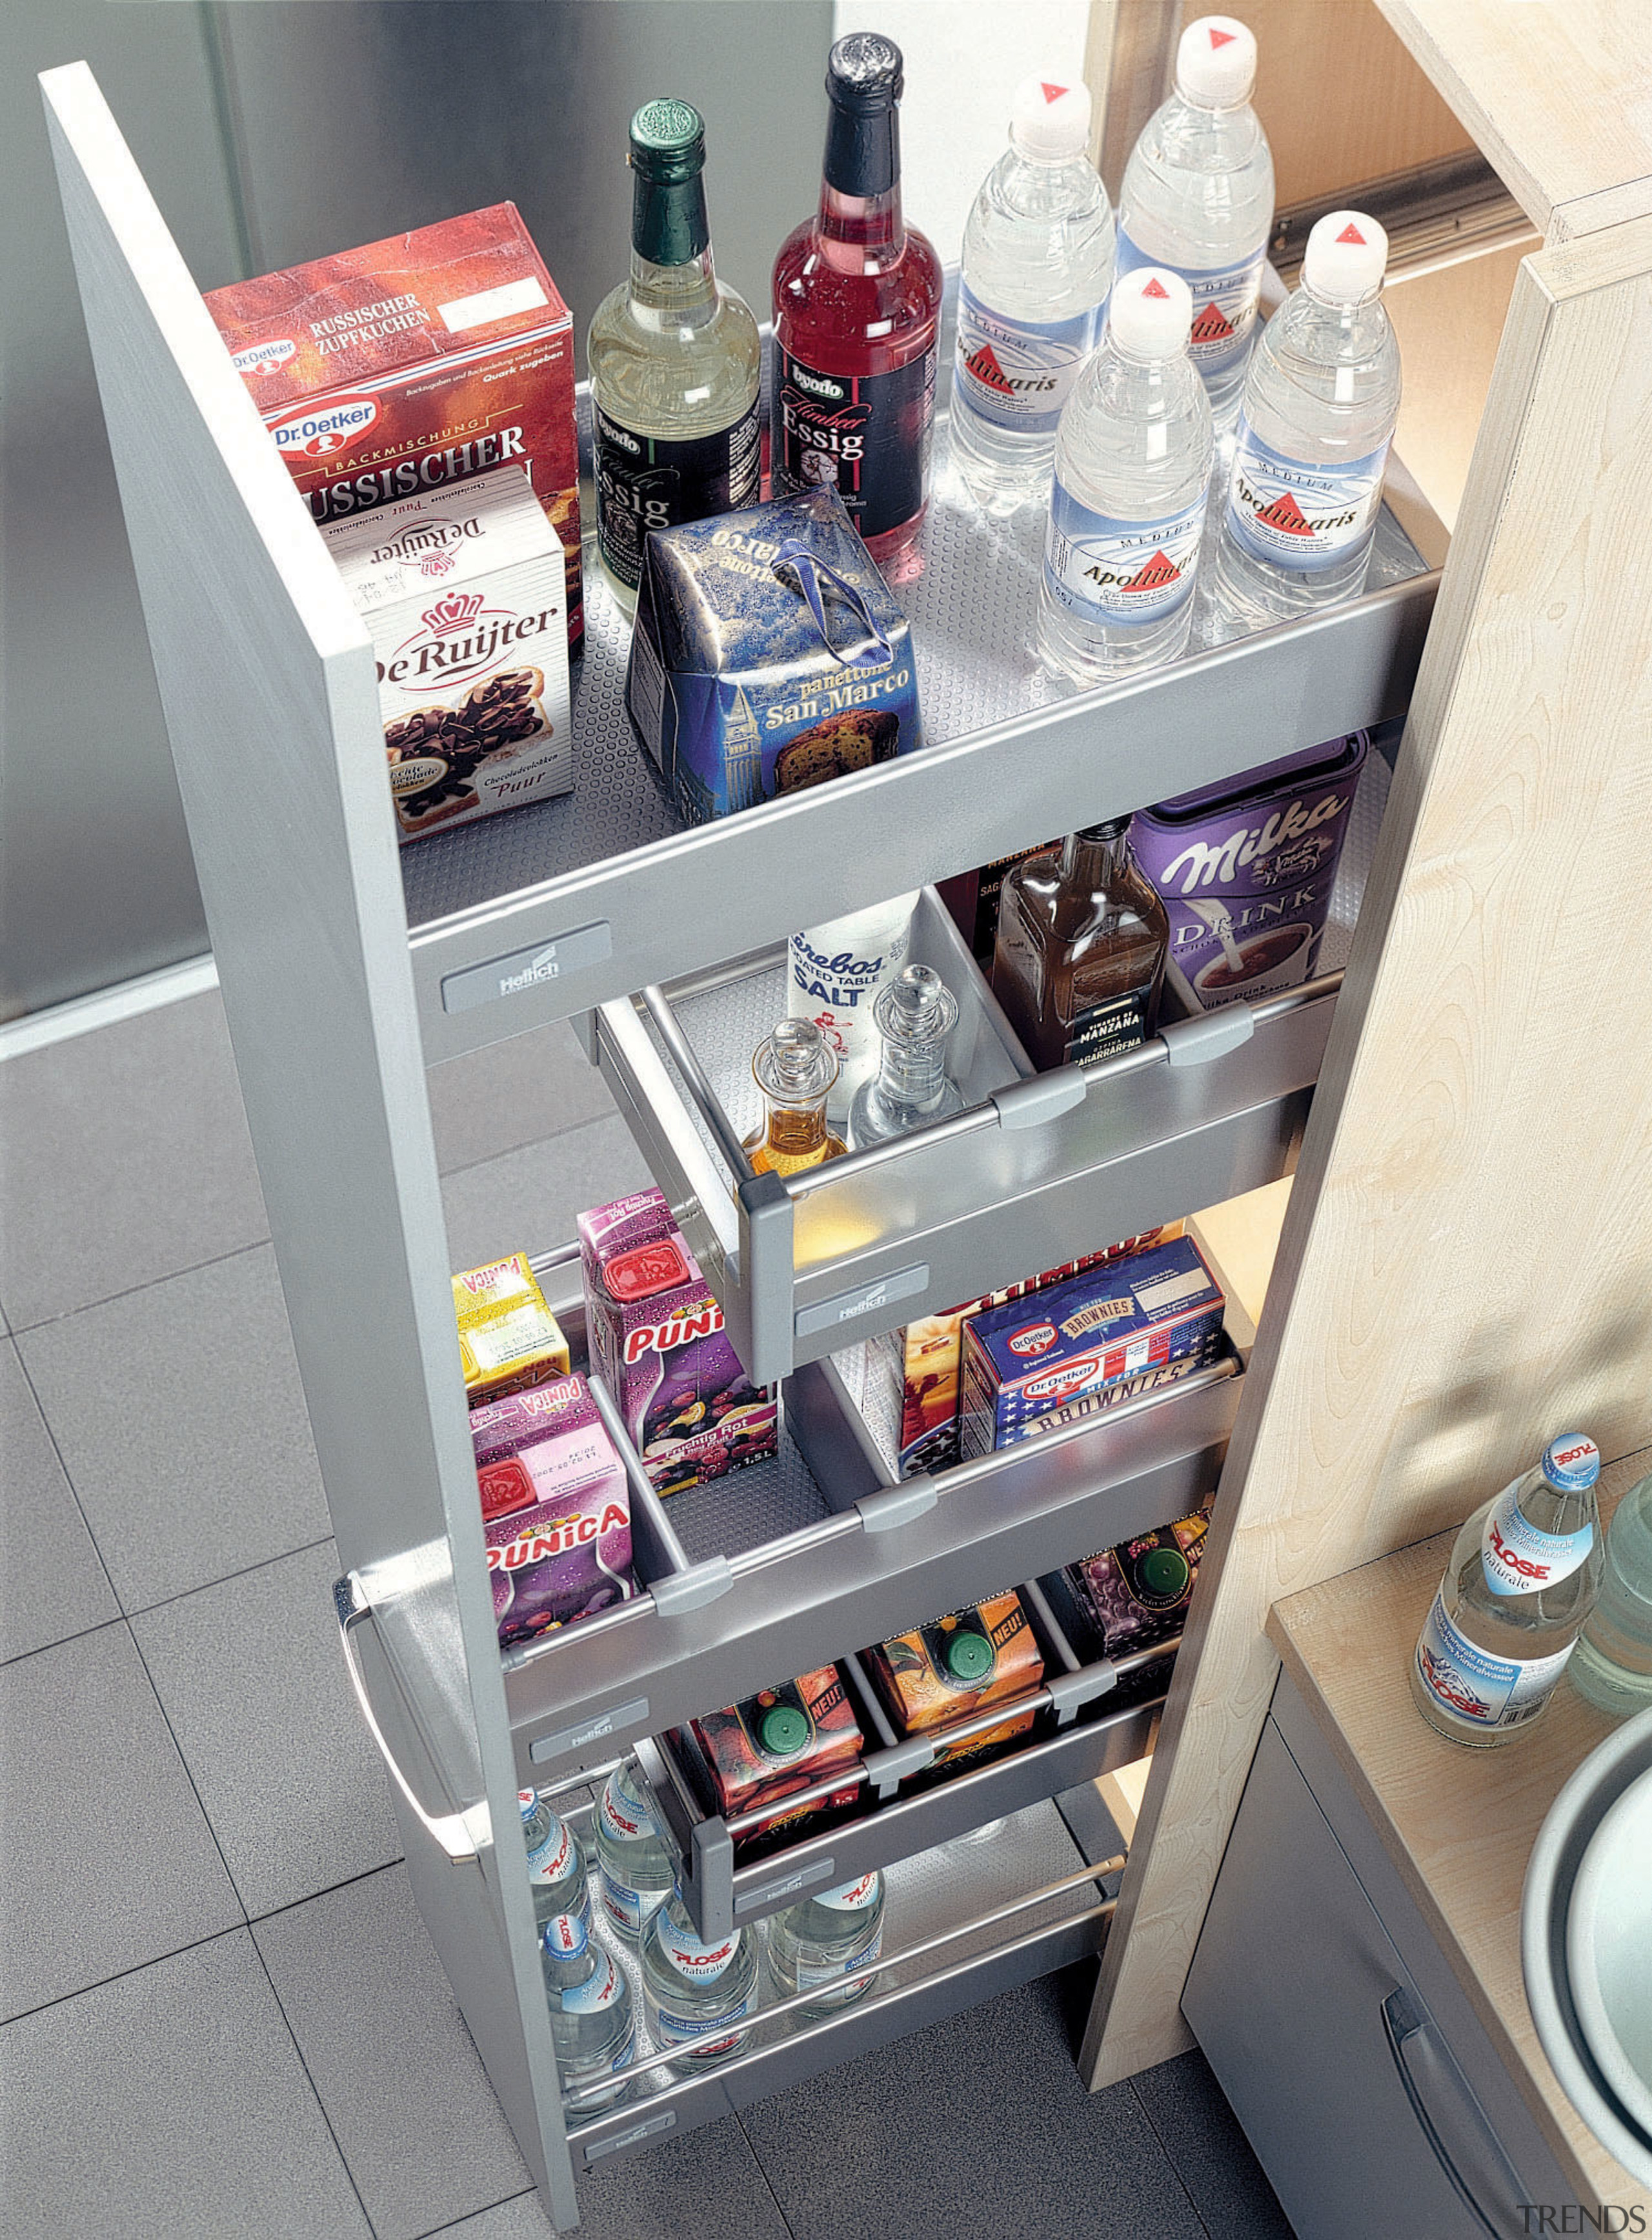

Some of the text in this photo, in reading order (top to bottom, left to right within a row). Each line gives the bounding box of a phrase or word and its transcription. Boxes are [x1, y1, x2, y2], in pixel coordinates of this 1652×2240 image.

[309, 293, 421, 338] RUSSISCHER
[315, 308, 431, 355] ZUPFKUCHEN
[452, 372, 467, 381] und
[483, 350, 563, 382] Quark zugeben
[958, 336, 1058, 392] pollinaris
[336, 419, 479, 470] BACKMISCHUNG
[783, 403, 864, 460] Essig
[301, 426, 527, 520] USSISCHER
[1258, 462, 1333, 491] MEDIUM
[1236, 478, 1356, 530] Apollinaris
[370, 517, 486, 565] De Ruijter
[410, 608, 558, 680] Ruijter
[766, 670, 909, 729] San Marco
[490, 772, 545, 798] Puur
[1160, 794, 1349, 894] Milka
[1174, 883, 1316, 946] DRINK
[791, 933, 883, 975] erebos
[794, 964, 865, 1007] SALT
[837, 974, 880, 985] TABLE
[1080, 1014, 1140, 1044] MANZANA
[627, 1307, 723, 1362] PUNi
[1067, 1301, 1129, 1334] BROWNIES
[523, 1356, 557, 1374] Neu
[1087, 1367, 1140, 1393] MIX FOR
[1037, 1364, 1184, 1432] BROWNIES
[721, 1419, 749, 1435] Rot
[1554, 1443, 1597, 1466] PLOSE
[1511, 1515, 1540, 1544] minerale
[1540, 1538, 1575, 1549] naturale
[1489, 1520, 1551, 1580] PLOSE
[1484, 1550, 1529, 1589] naturale
[994, 1613, 1023, 1646] NEU!
[1455, 1651, 1515, 1682] Mineralwasser
[1477, 1659, 1514, 1673] naturale
[812, 1686, 842, 1721] NEU!
[558, 1915, 573, 1950] PLOSE
[672, 1942, 732, 1966] PLOSE
[683, 1960, 725, 1975] naturale
